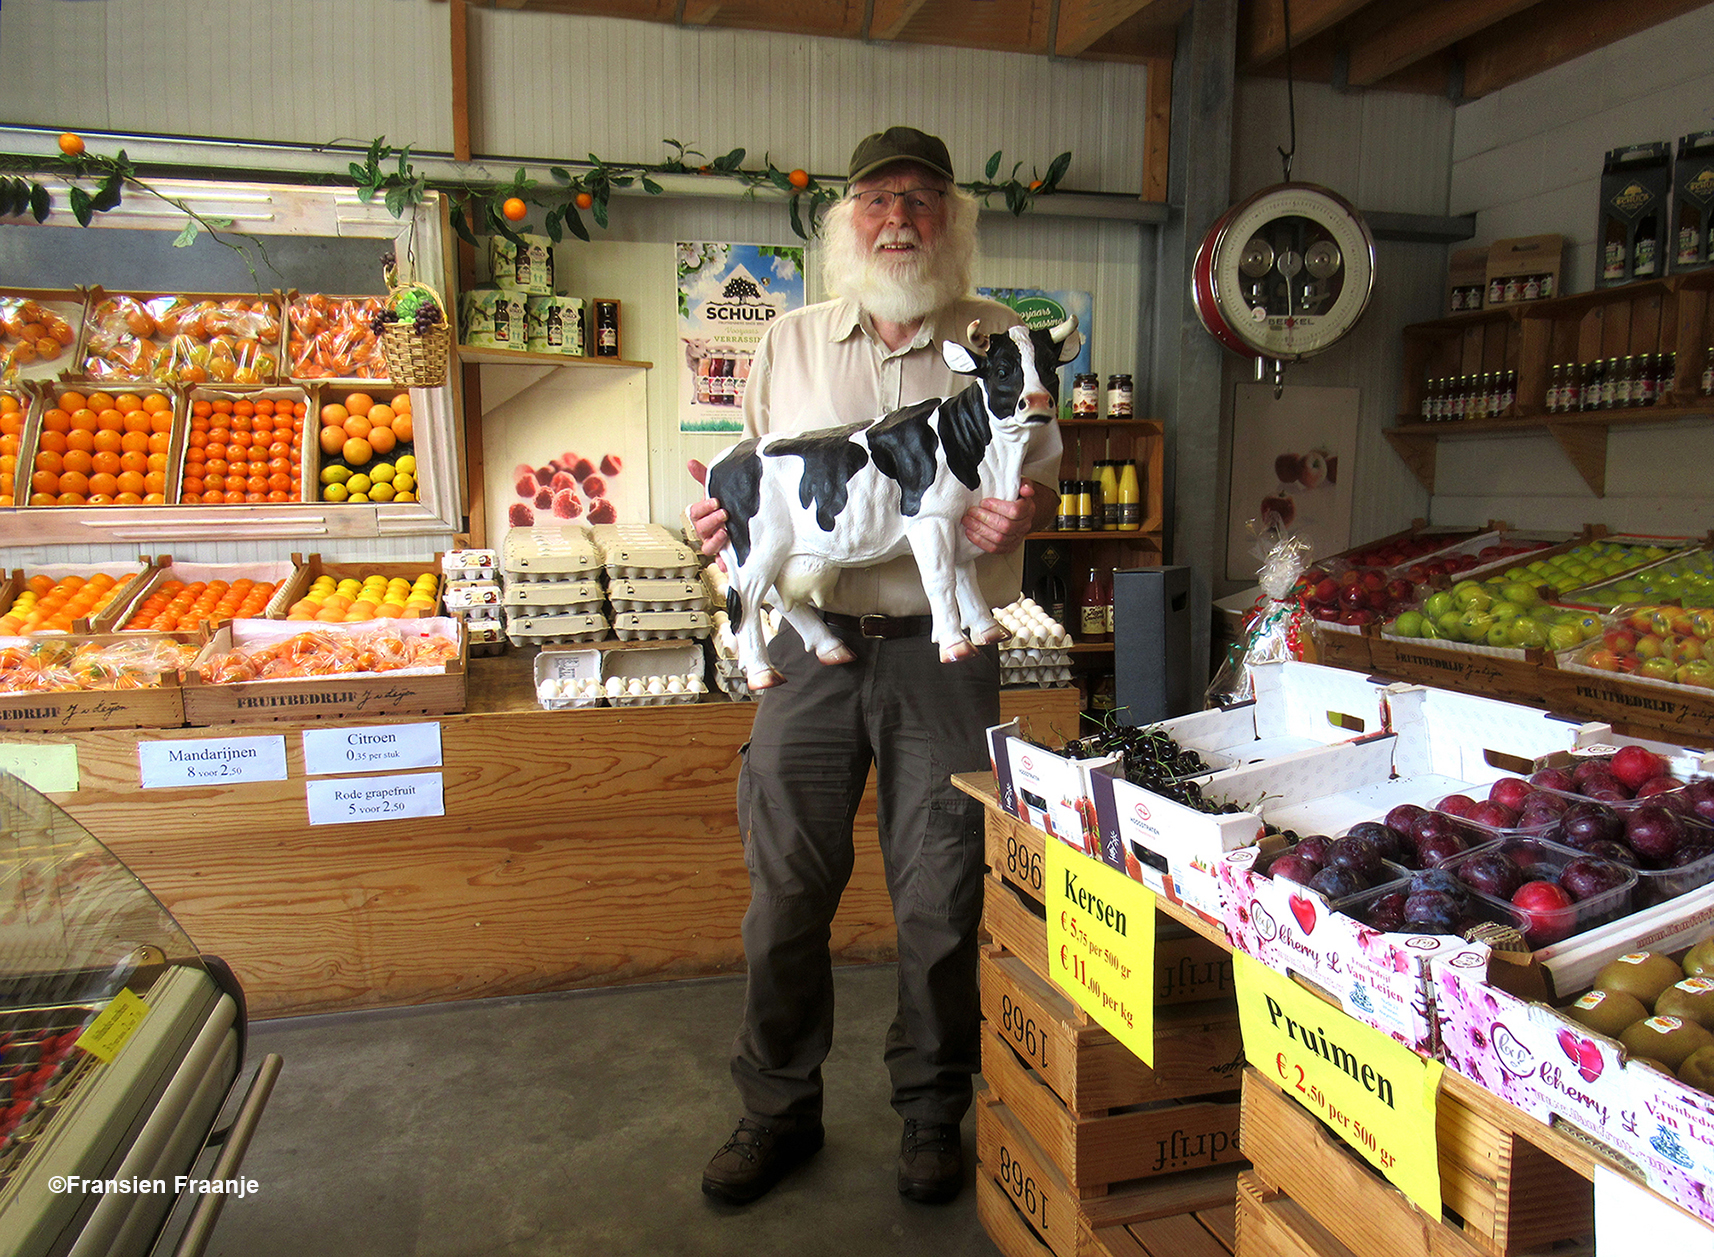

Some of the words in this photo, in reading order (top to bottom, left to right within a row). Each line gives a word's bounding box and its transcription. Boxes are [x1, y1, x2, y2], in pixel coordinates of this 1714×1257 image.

[706, 307, 776, 321] SCHULP
[713, 335, 763, 343] VERRASSIN
[236, 691, 357, 709] FRUITBEDRIJF
[346, 731, 396, 745] Citroen
[168, 747, 257, 763] Mandarijnen
[368, 752, 383, 762] per
[383, 749, 401, 760] stuk
[187, 765, 196, 777] 8
[198, 768, 218, 777] voor
[334, 788, 363, 801] Rode
[364, 785, 416, 803] grapefruit
[348, 803, 357, 815] 5
[359, 804, 381, 813] voor
[1064, 867, 1127, 938] Kersen
[1061, 910, 1068, 932] €
[1089, 939, 1103, 958] per
[1103, 949, 1119, 971] 500
[1120, 965, 1132, 980] gr
[1279, 923, 1321, 968] Cherry
[1346, 962, 1366, 983] Van
[1371, 977, 1404, 1004] Leijen
[1350, 956, 1392, 984] Fruitbedrijf
[1060, 944, 1069, 971] €
[1102, 990, 1118, 1013] per
[1120, 1001, 1134, 1030] kg
[1263, 991, 1396, 1111] Pruimen
[1539, 1060, 1610, 1127] Cherry
[1275, 1052, 1289, 1080] €
[1328, 1101, 1350, 1128] per
[1353, 1120, 1377, 1153] 500
[1380, 1147, 1396, 1169] gr
[1643, 1100, 1679, 1129] Van
[1152, 1128, 1241, 1171] edrijf
